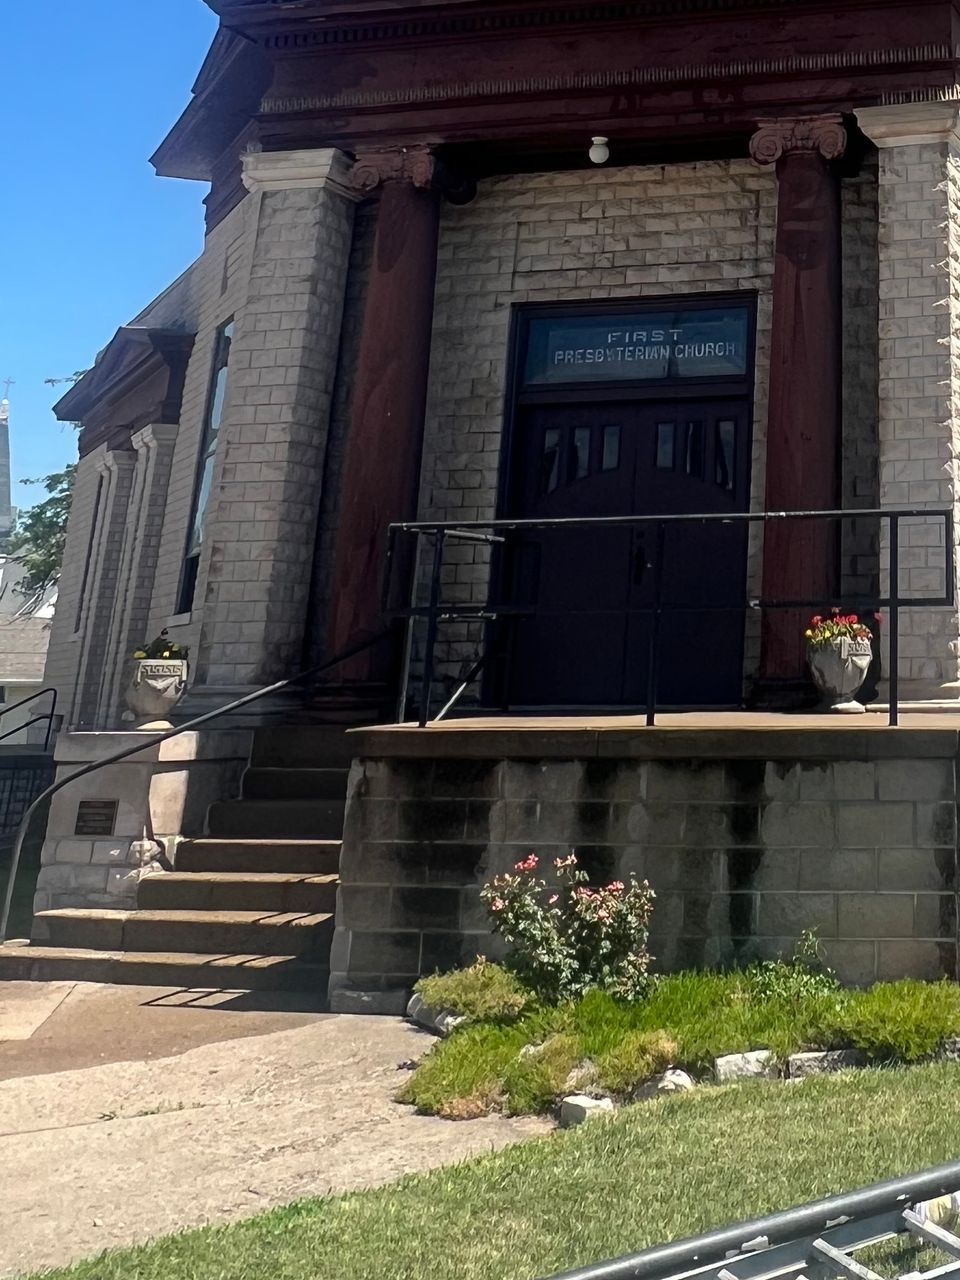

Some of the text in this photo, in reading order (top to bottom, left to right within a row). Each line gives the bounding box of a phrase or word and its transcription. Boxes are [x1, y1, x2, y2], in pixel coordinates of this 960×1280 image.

[607, 329, 683, 343] FIRST
[554, 341, 736, 365] PRESBYTERIAN CHURCH
